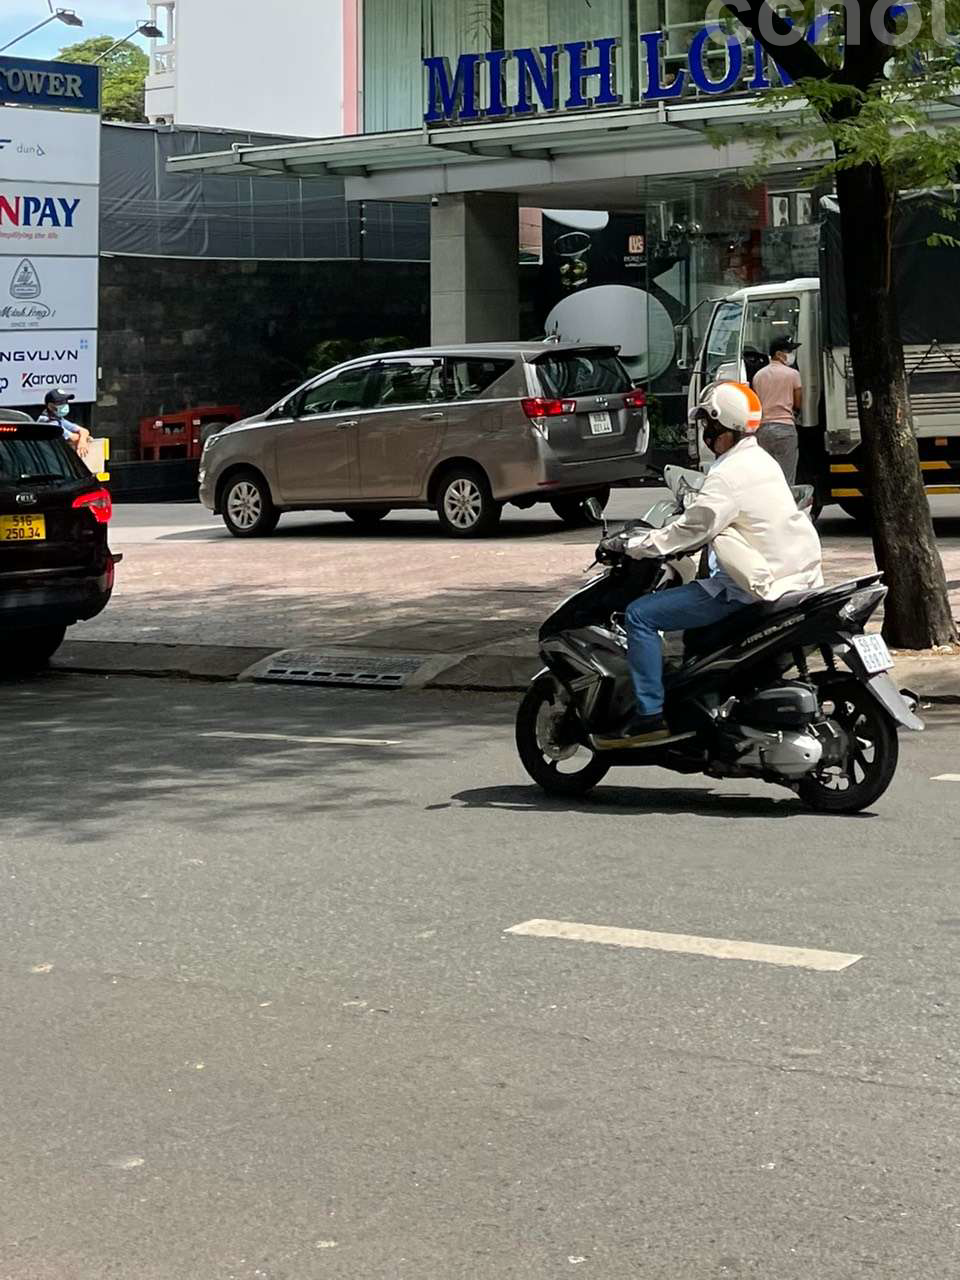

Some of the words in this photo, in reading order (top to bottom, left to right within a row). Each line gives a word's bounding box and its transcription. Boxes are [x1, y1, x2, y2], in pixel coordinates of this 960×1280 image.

[0, 67, 83, 98] OWER
[423, 37, 621, 123] MINH
[22, 372, 78, 388] Karavan
